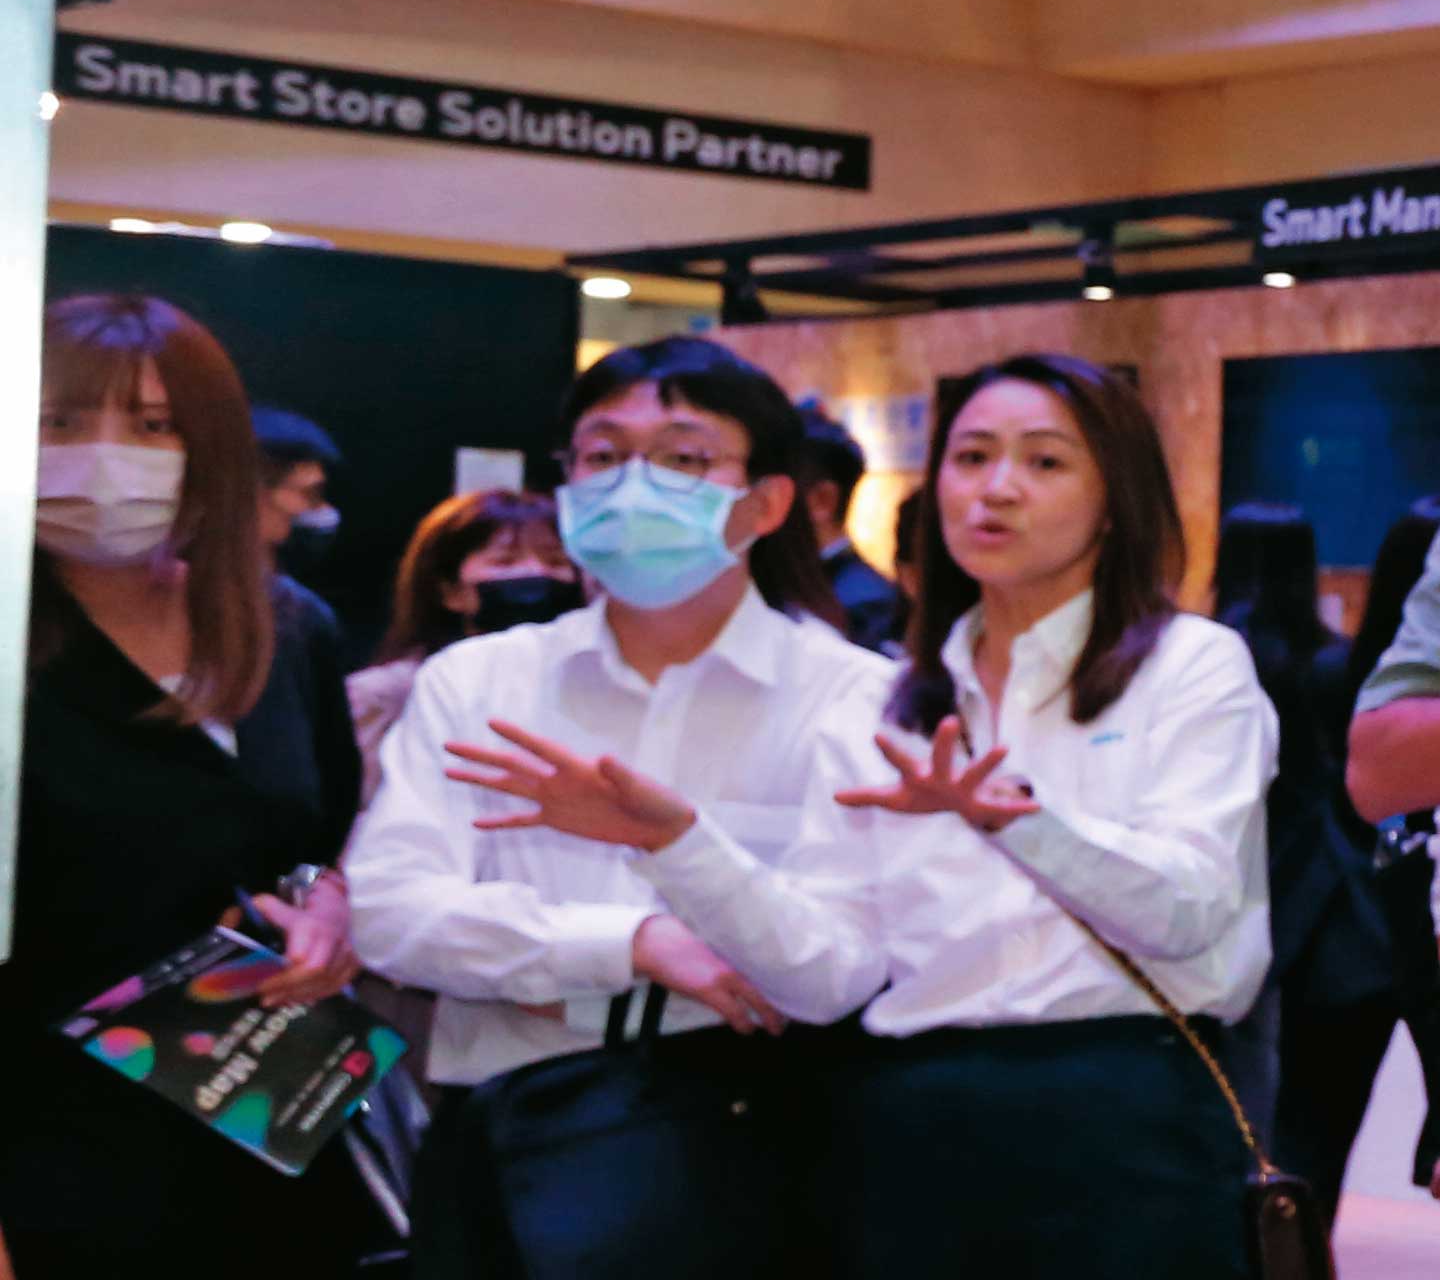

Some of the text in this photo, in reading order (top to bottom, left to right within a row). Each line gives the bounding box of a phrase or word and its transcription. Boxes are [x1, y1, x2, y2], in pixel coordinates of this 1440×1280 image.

[77, 46, 844, 180] Smart Store Solution Partner
[1262, 196, 1366, 248] Smart
